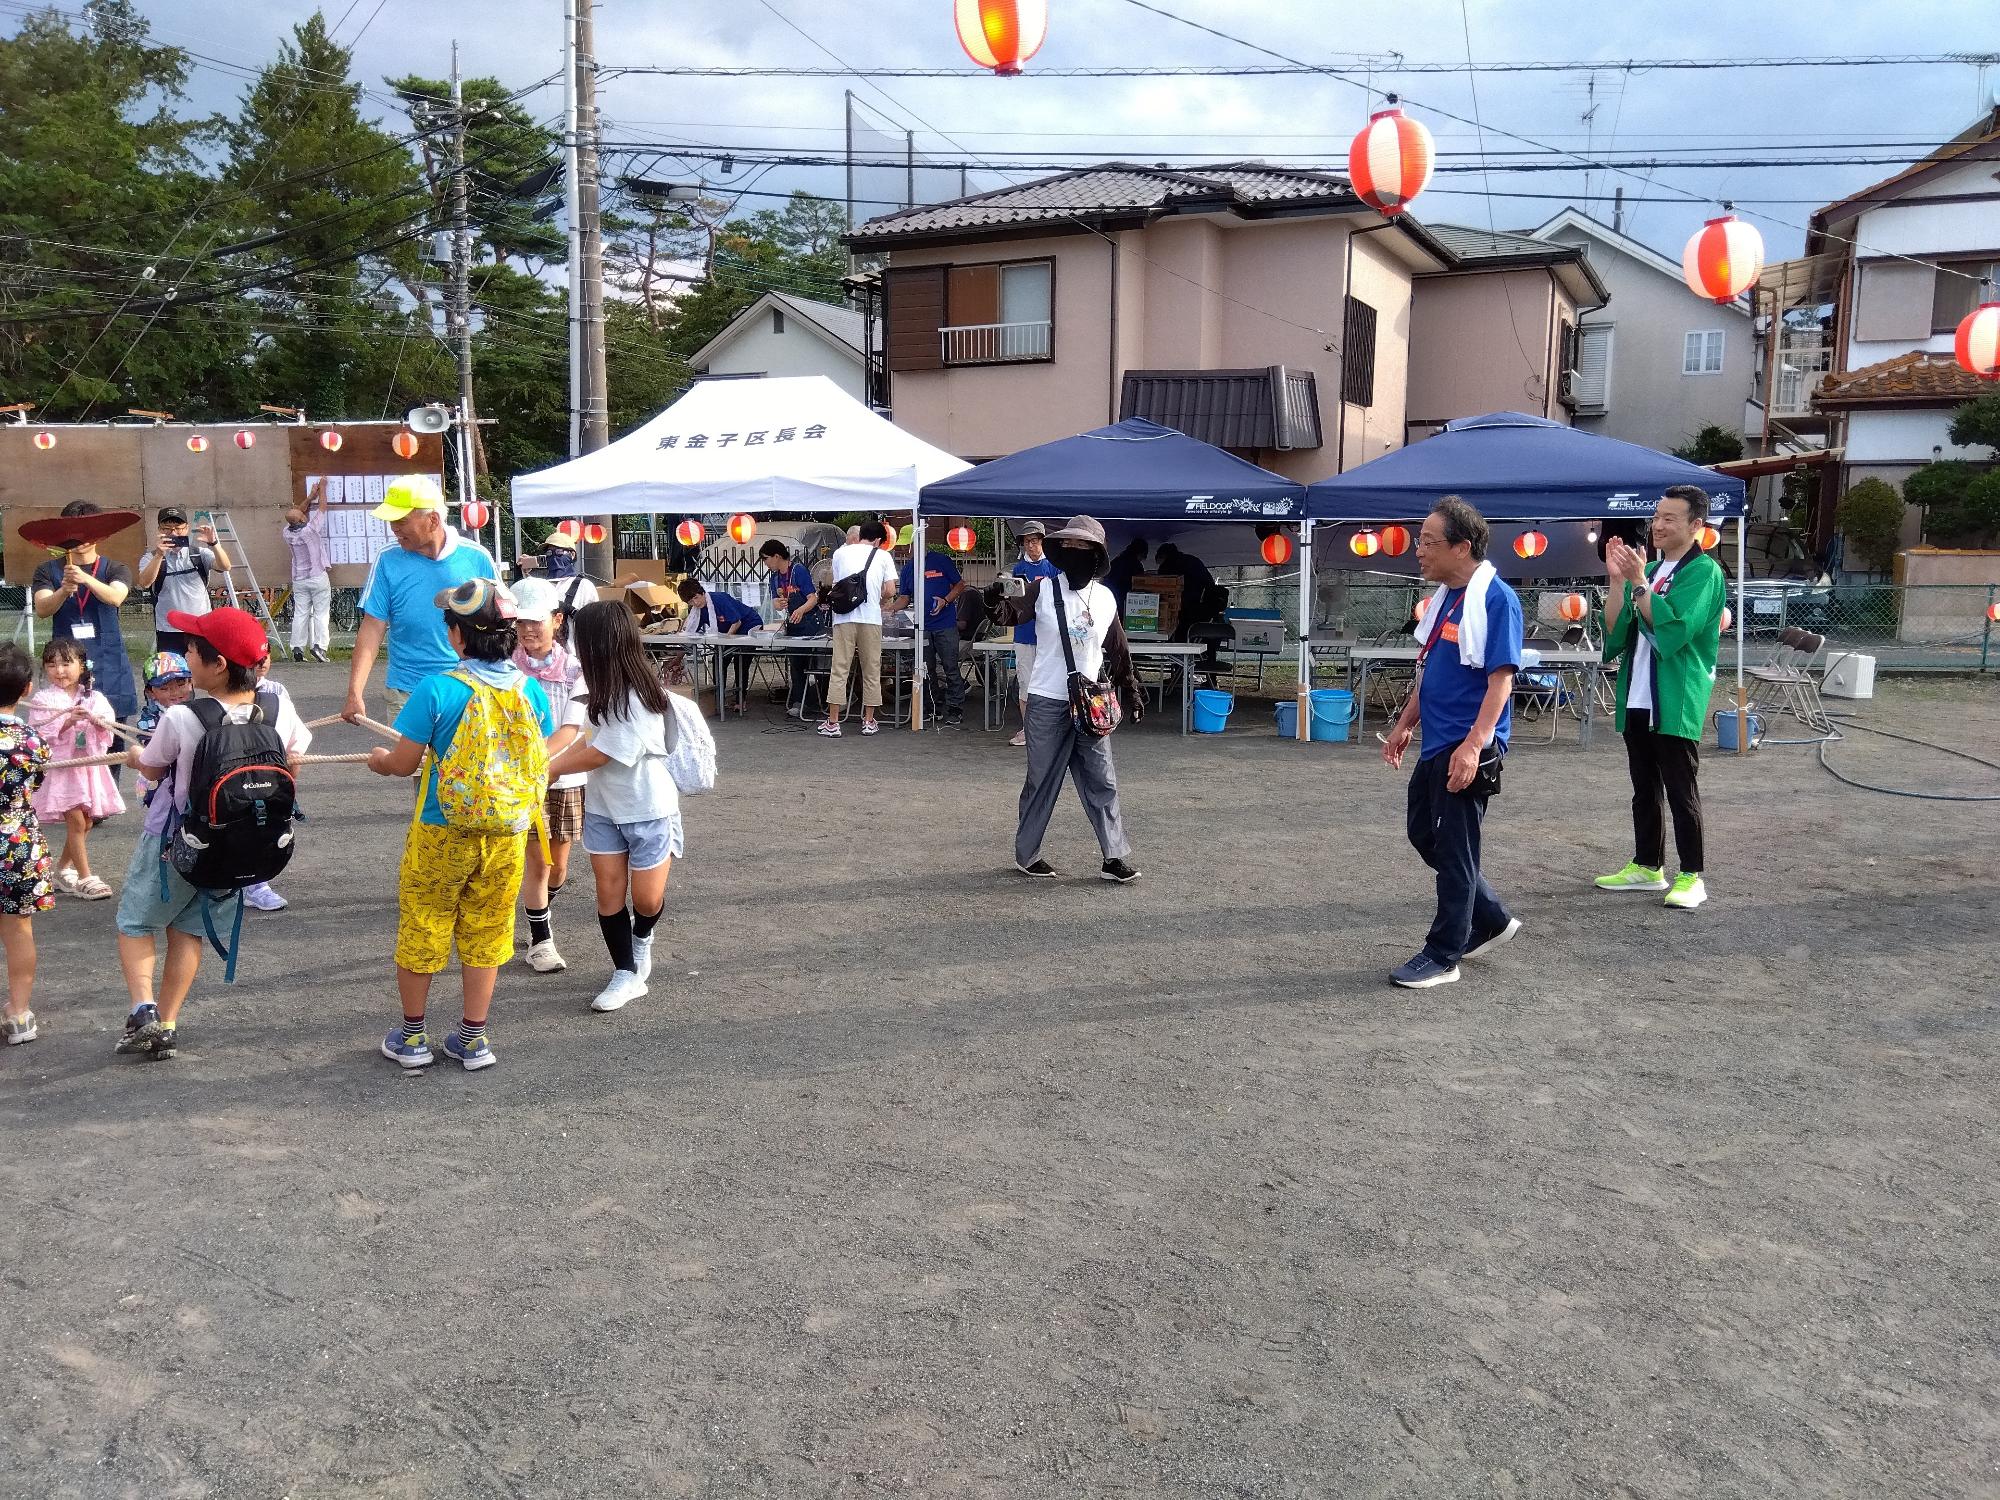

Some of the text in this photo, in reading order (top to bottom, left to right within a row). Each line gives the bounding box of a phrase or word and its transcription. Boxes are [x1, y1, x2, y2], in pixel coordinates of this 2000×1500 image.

[655, 423, 828, 450] 東金子区長会
